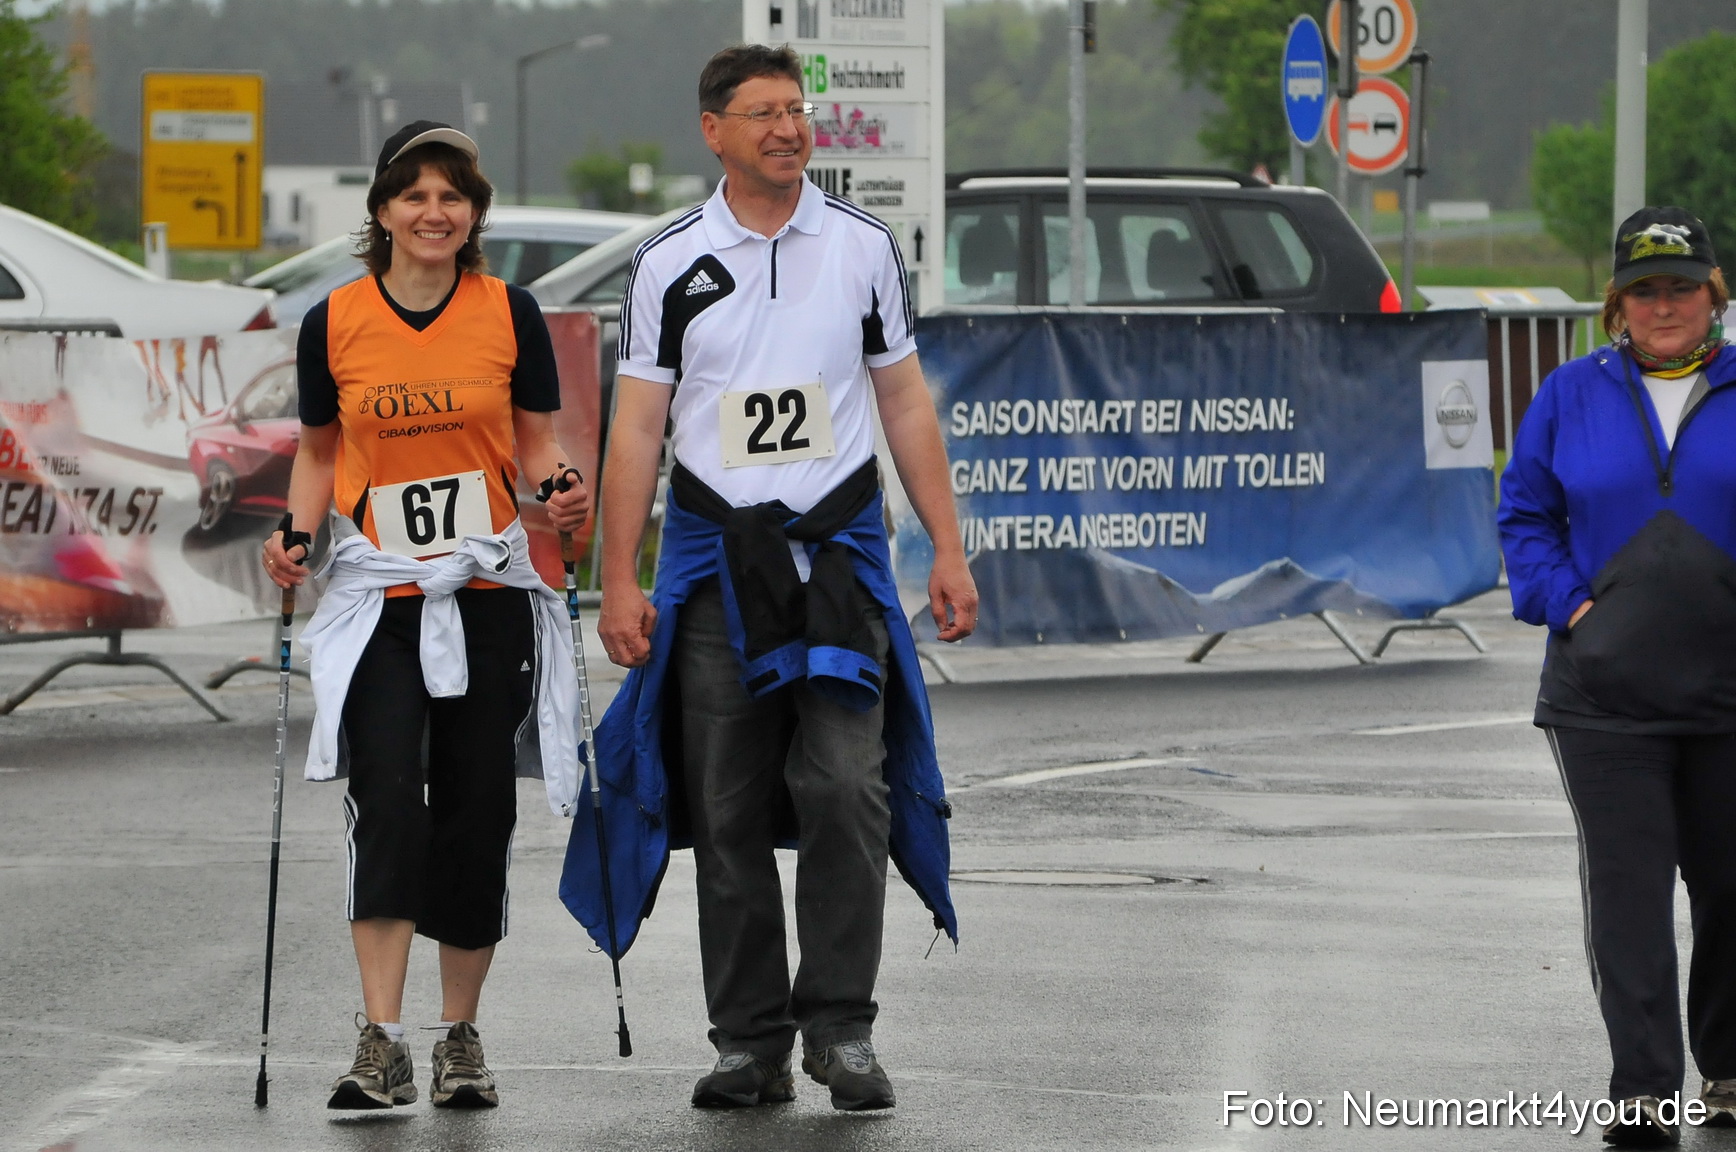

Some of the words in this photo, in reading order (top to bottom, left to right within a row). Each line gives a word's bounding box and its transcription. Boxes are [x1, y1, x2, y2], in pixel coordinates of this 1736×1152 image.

[685, 282, 720, 296] adidas
[410, 381, 437, 391] UHREN
[439, 380, 455, 388] UND
[458, 379, 494, 387] SCHMUCK
[374, 389, 464, 420] OEXL
[744, 388, 811, 455] 22
[950, 400, 1136, 438] SAISONSTART
[1141, 399, 1183, 434] BEI
[1189, 397, 1295, 433] NISSAN:
[1440, 408, 1474, 420] NISSAN
[50, 455, 80, 476] NEUE
[951, 458, 1029, 495] GANZ
[1038, 456, 1097, 492] WEIT
[1101, 455, 1174, 491] VORN
[1183, 454, 1229, 489] MIT
[1234, 451, 1325, 488] TOLLEN
[118, 486, 163, 536] ST.
[401, 477, 460, 546] 67
